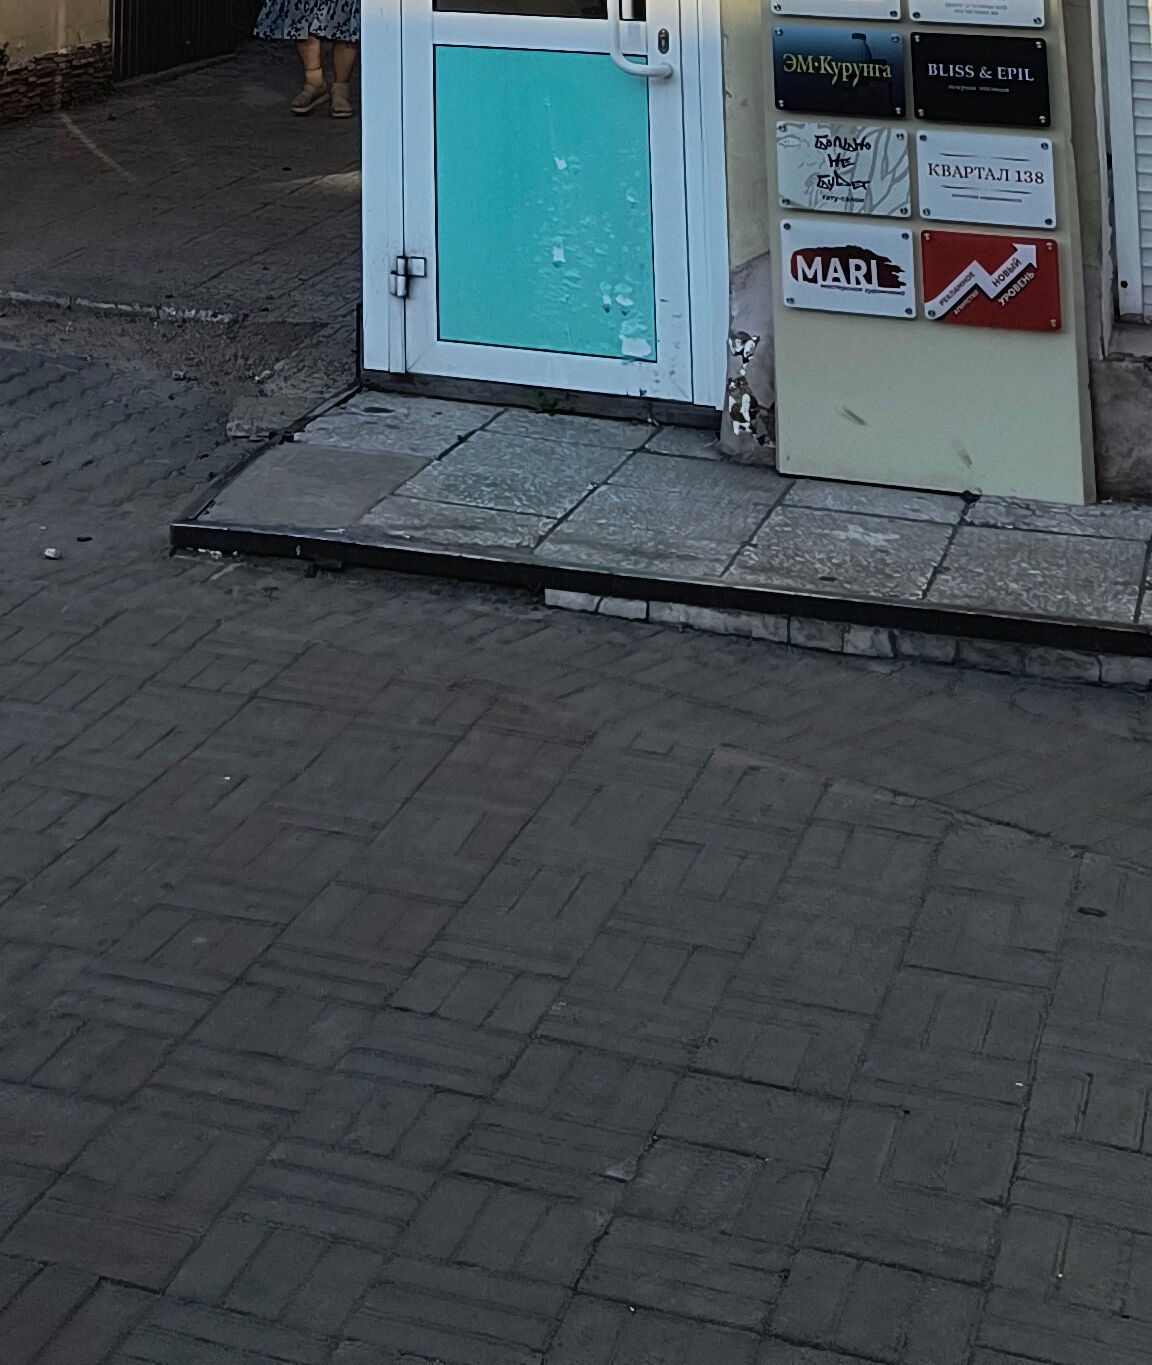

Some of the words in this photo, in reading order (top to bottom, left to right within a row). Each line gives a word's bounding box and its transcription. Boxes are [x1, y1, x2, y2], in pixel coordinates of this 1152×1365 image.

[927, 63, 975, 78] BLISS
[979, 65, 993, 79] &
[997, 66, 1035, 81] EPIL
[927, 162, 1010, 181] КВАРТАЛ
[1015, 170, 1045, 185] 138
[796, 254, 879, 288] MARI
[991, 256, 1023, 288] НОВЫЙ
[997, 271, 1035, 307] УРОВЕНЬ
